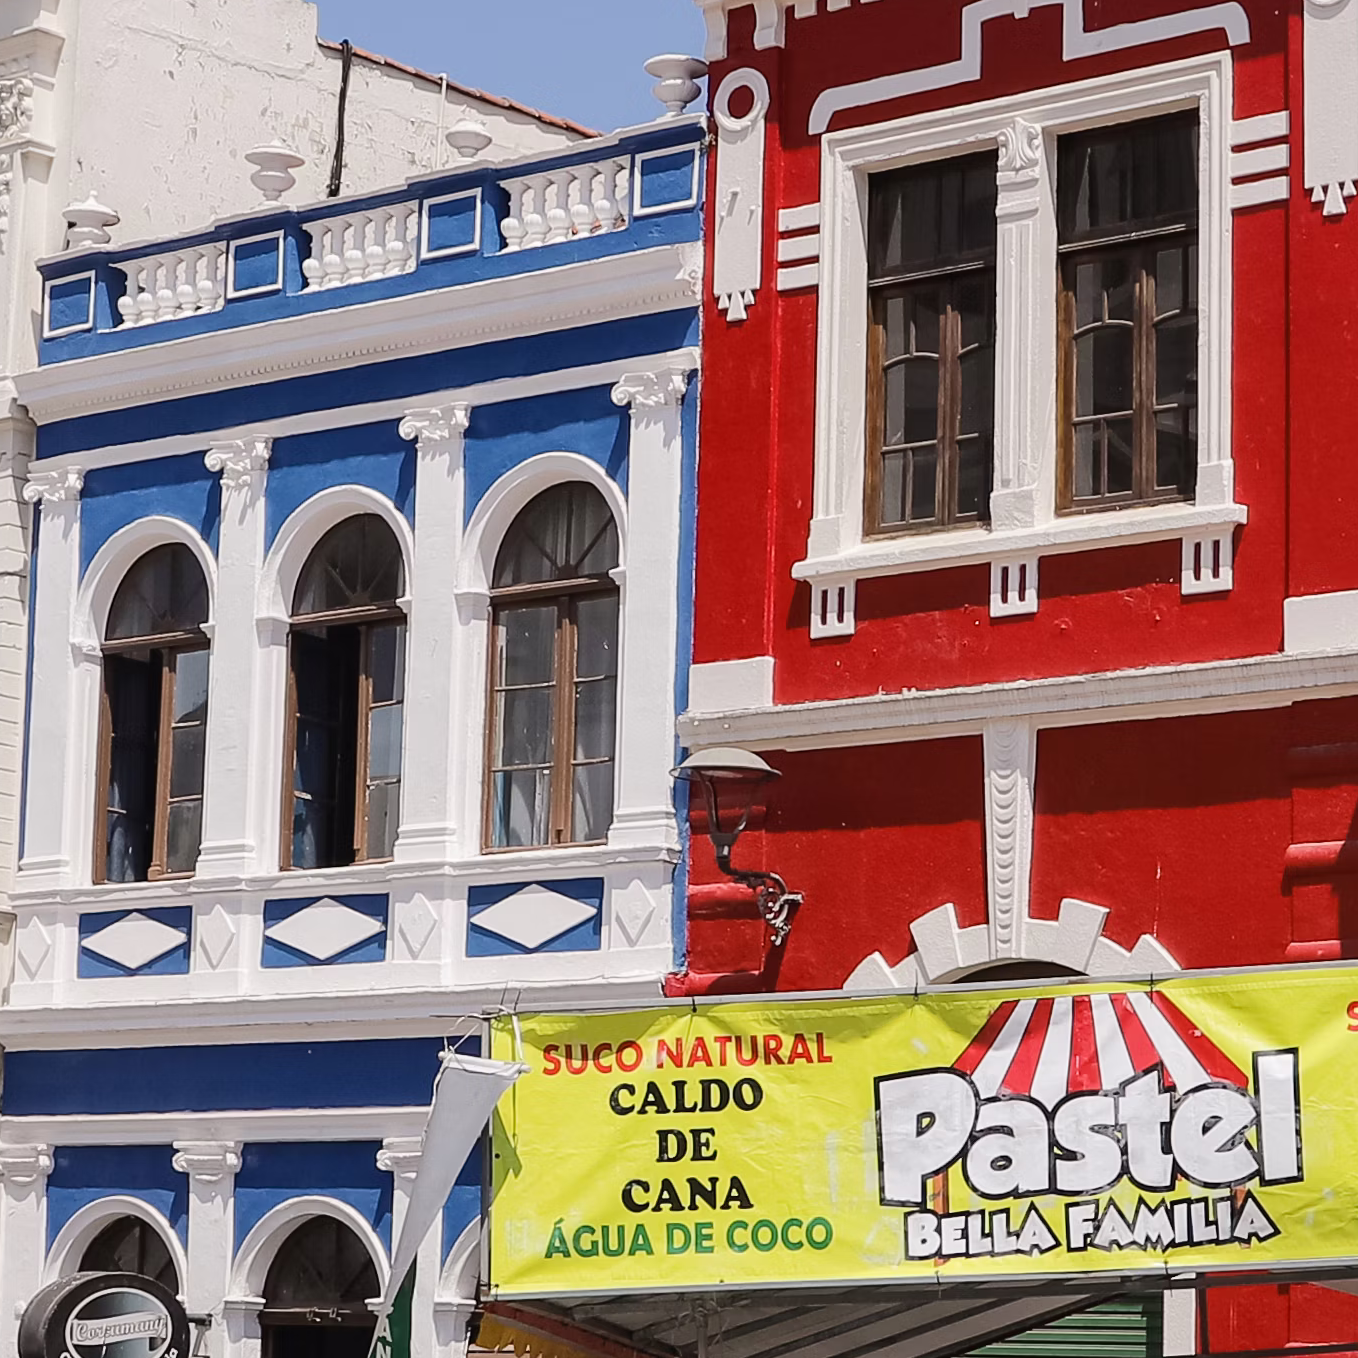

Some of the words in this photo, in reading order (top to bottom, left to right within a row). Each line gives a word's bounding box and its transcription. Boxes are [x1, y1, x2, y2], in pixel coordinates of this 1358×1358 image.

[542, 1039, 643, 1076] SUCO
[656, 1032, 834, 1070] NATURAL
[609, 1077, 764, 1116] CALDO
[656, 1127, 718, 1163] DE
[873, 1046, 1304, 1209] Pastel
[621, 1175, 754, 1213] CANA
[544, 1217, 654, 1259] ÁGUA
[666, 1222, 715, 1254] DE
[726, 1216, 834, 1253] COCO
[904, 1200, 1062, 1261] BELLA
[1065, 1188, 1281, 1253] FAMILIA
